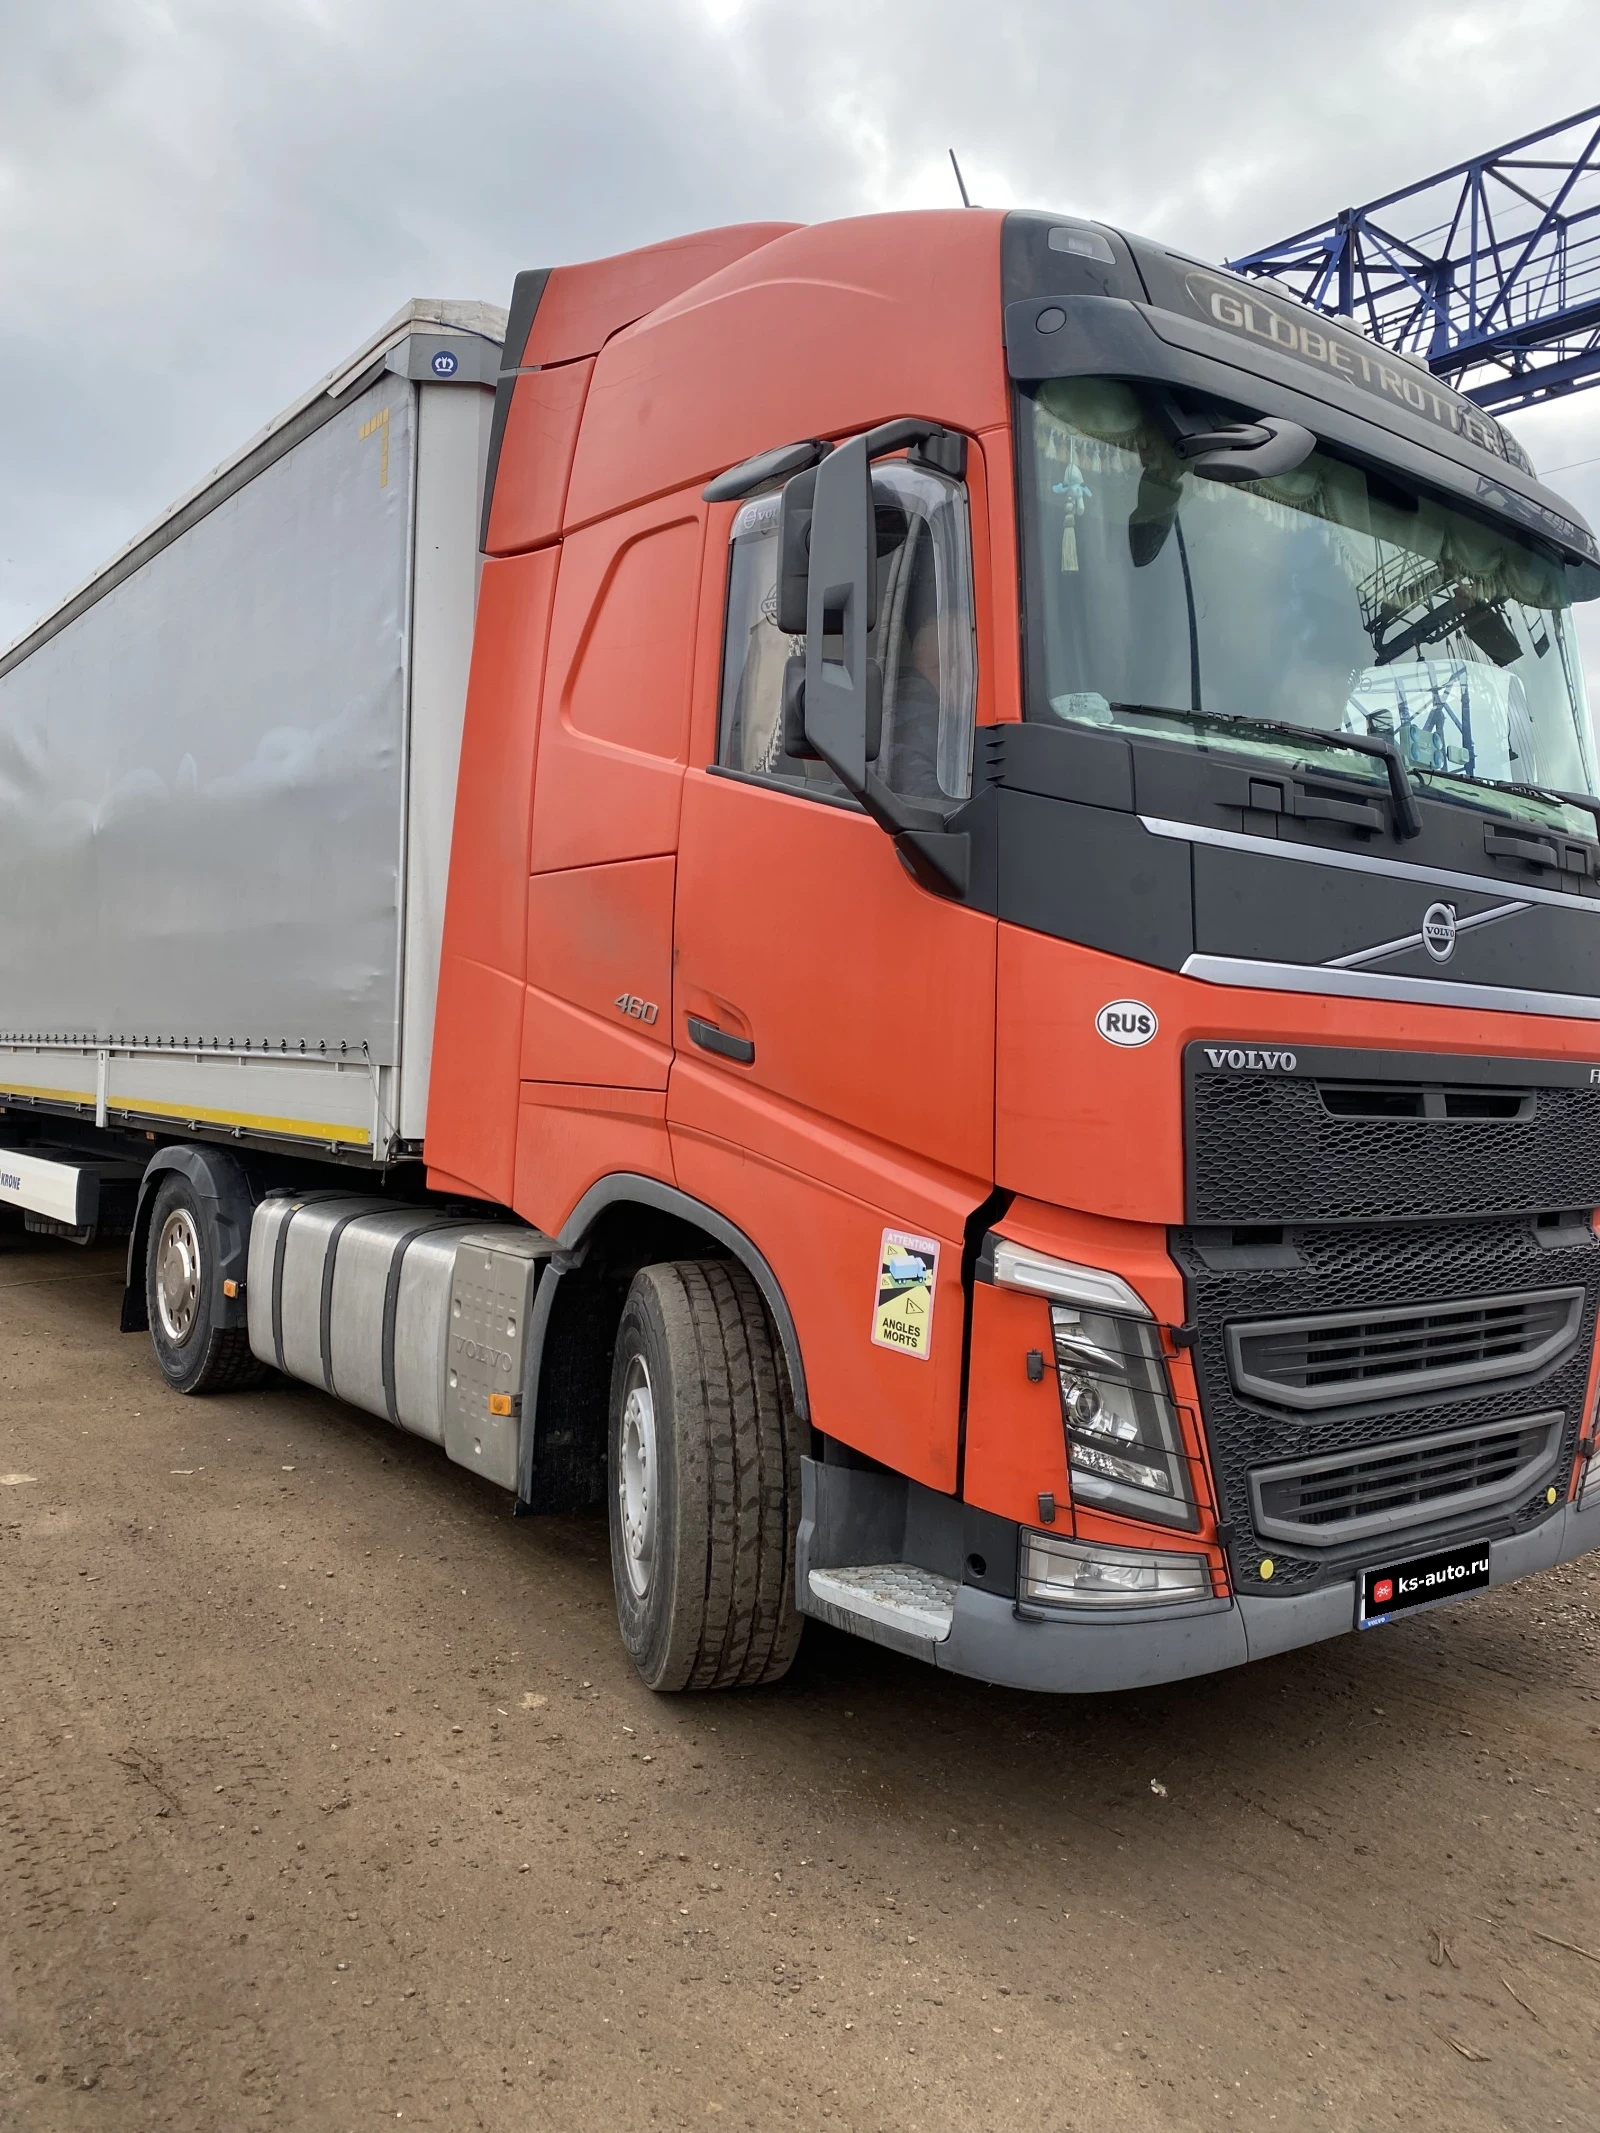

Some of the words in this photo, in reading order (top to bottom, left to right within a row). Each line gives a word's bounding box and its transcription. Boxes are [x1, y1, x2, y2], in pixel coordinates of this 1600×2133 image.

[1211, 292, 1500, 456] GLOBETROTTER
[1425, 926, 1455, 938] VOLVO
[614, 993, 659, 1026] 460
[1105, 1012, 1151, 1034] RUS
[1204, 1048, 1297, 1072] VOLVO
[1, 1172, 21, 1191] KRONE
[887, 1233, 934, 1252] ATTENTION
[882, 1317, 920, 1337] ANGLES
[883, 1328, 918, 1348] MORTS
[452, 1332, 513, 1373] VOLVO
